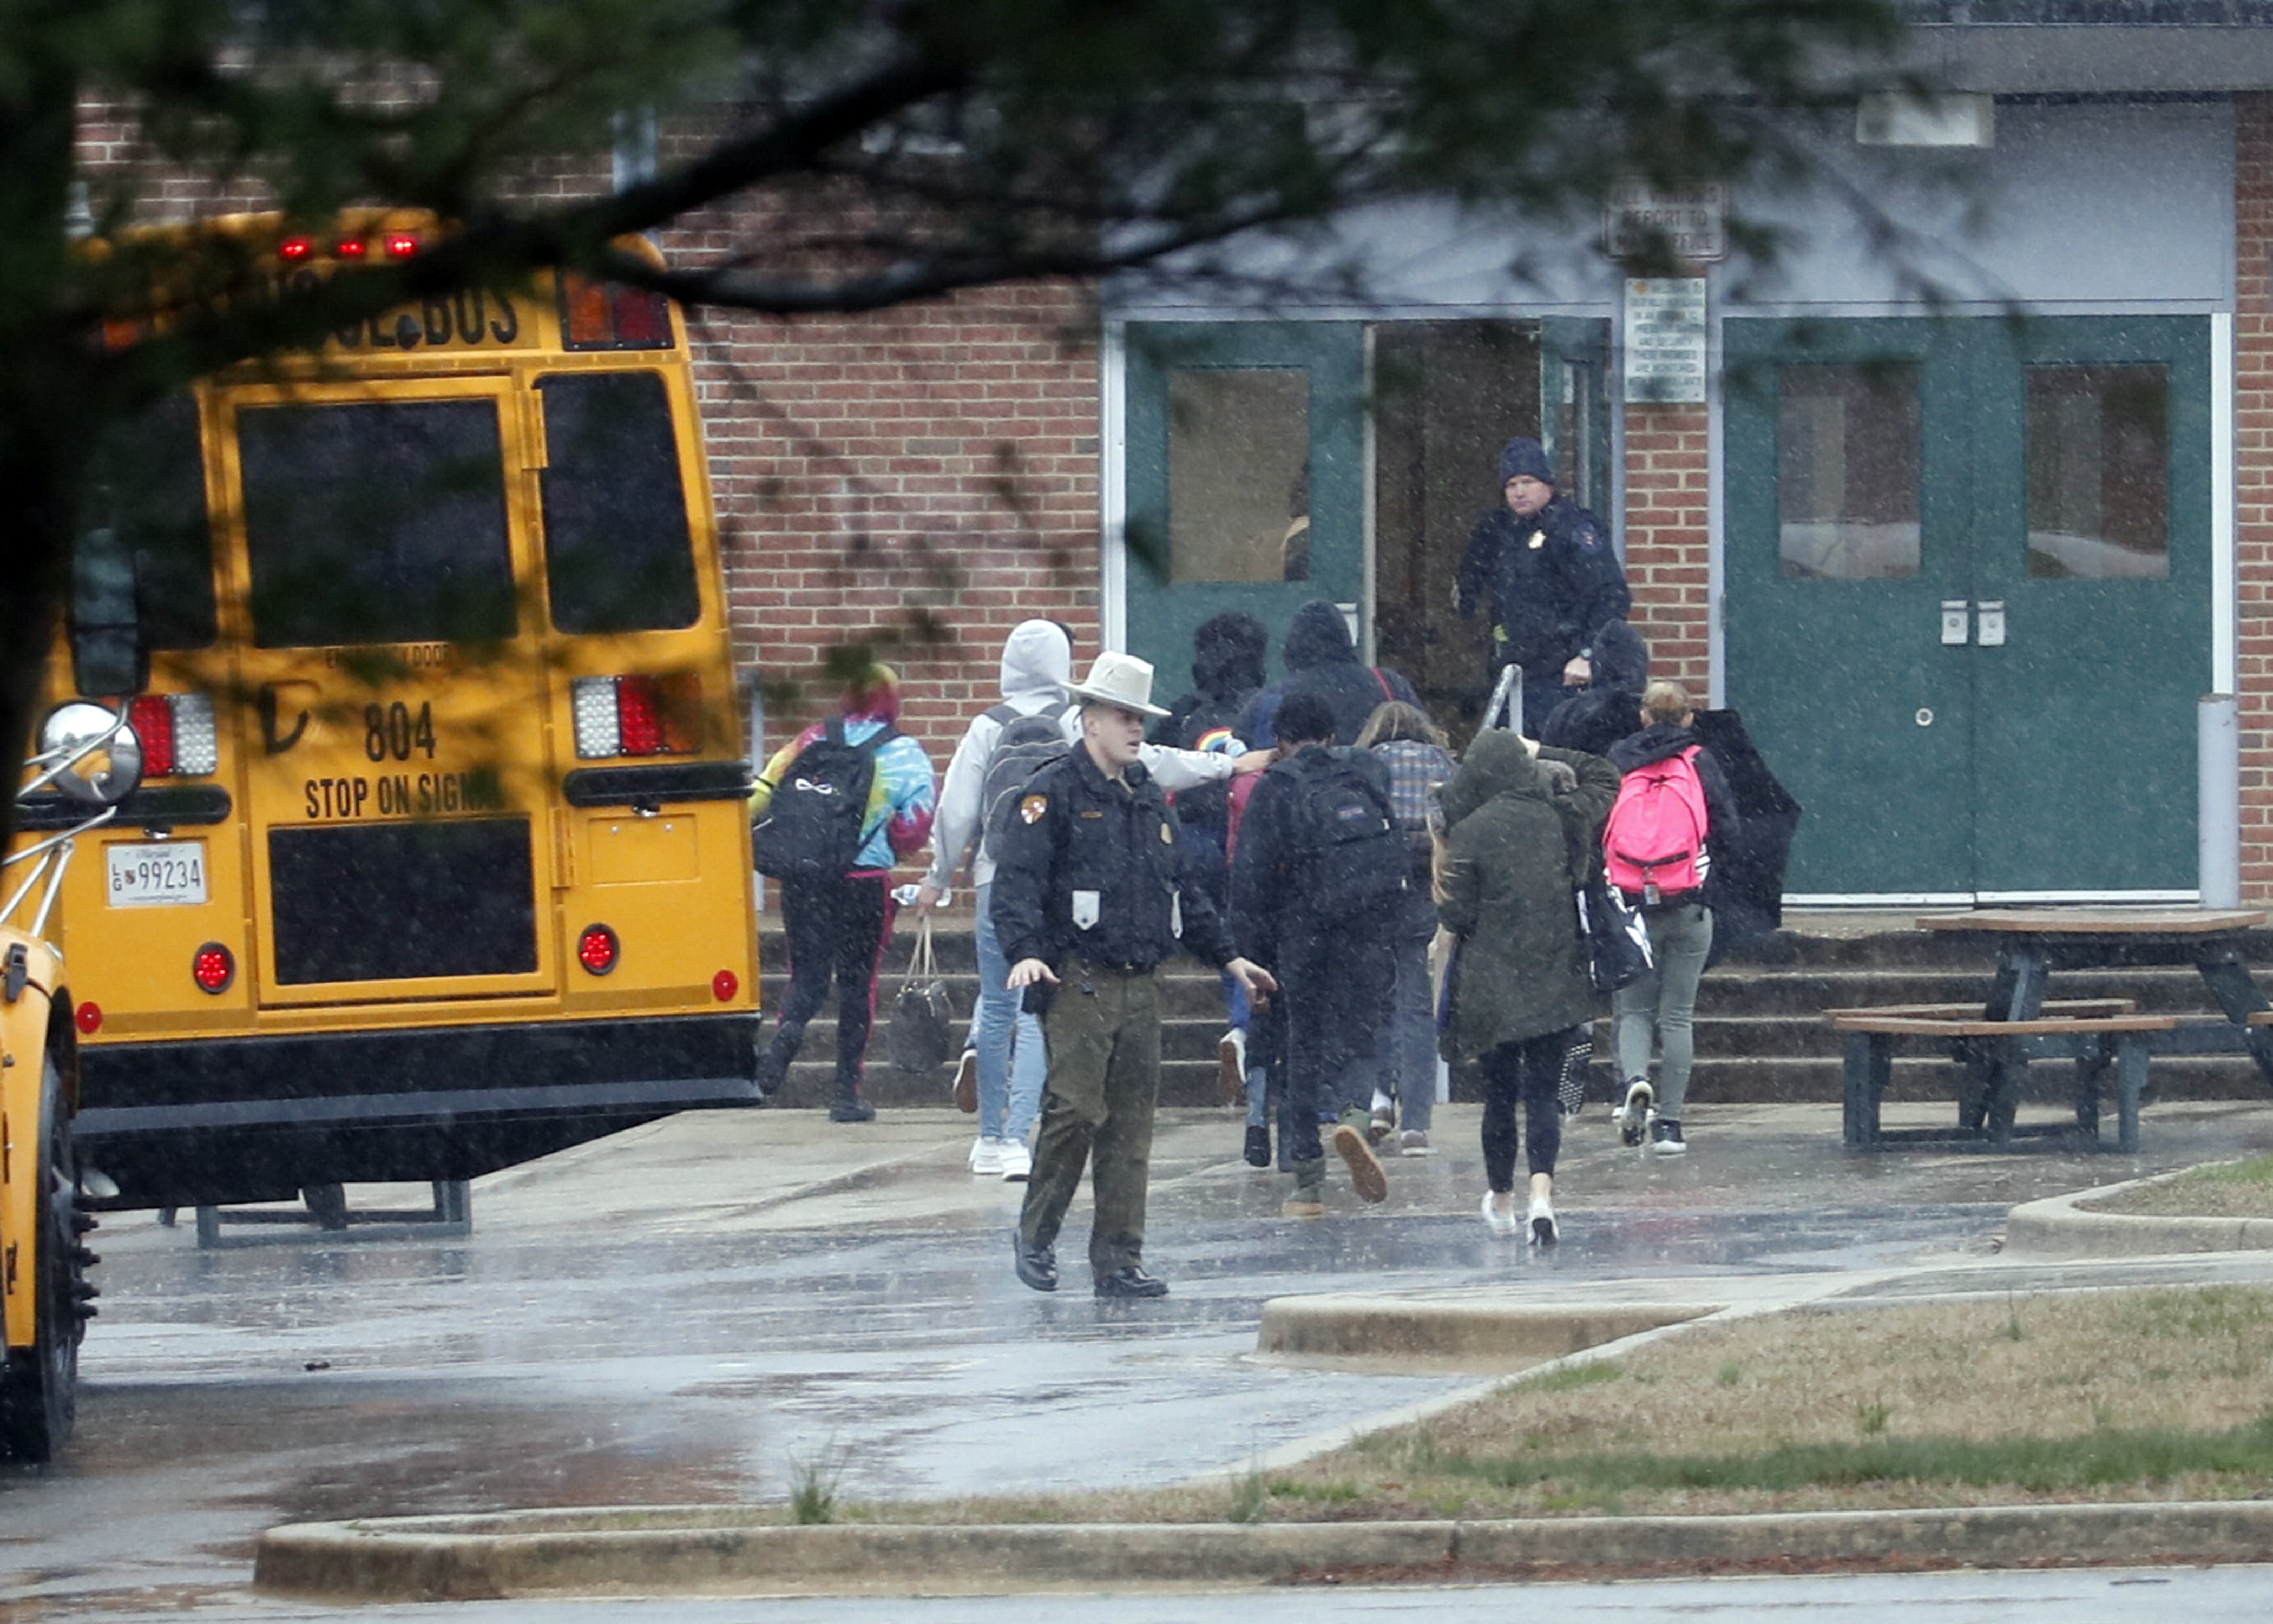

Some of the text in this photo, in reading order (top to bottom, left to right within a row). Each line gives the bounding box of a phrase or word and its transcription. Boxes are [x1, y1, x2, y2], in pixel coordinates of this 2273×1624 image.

[1690, 209, 1707, 227] TO
[422, 287, 518, 345] BUS
[365, 702, 435, 761] 804
[306, 778, 368, 818] STOP
[378, 775, 410, 816] ON
[139, 859, 200, 890] 99234
